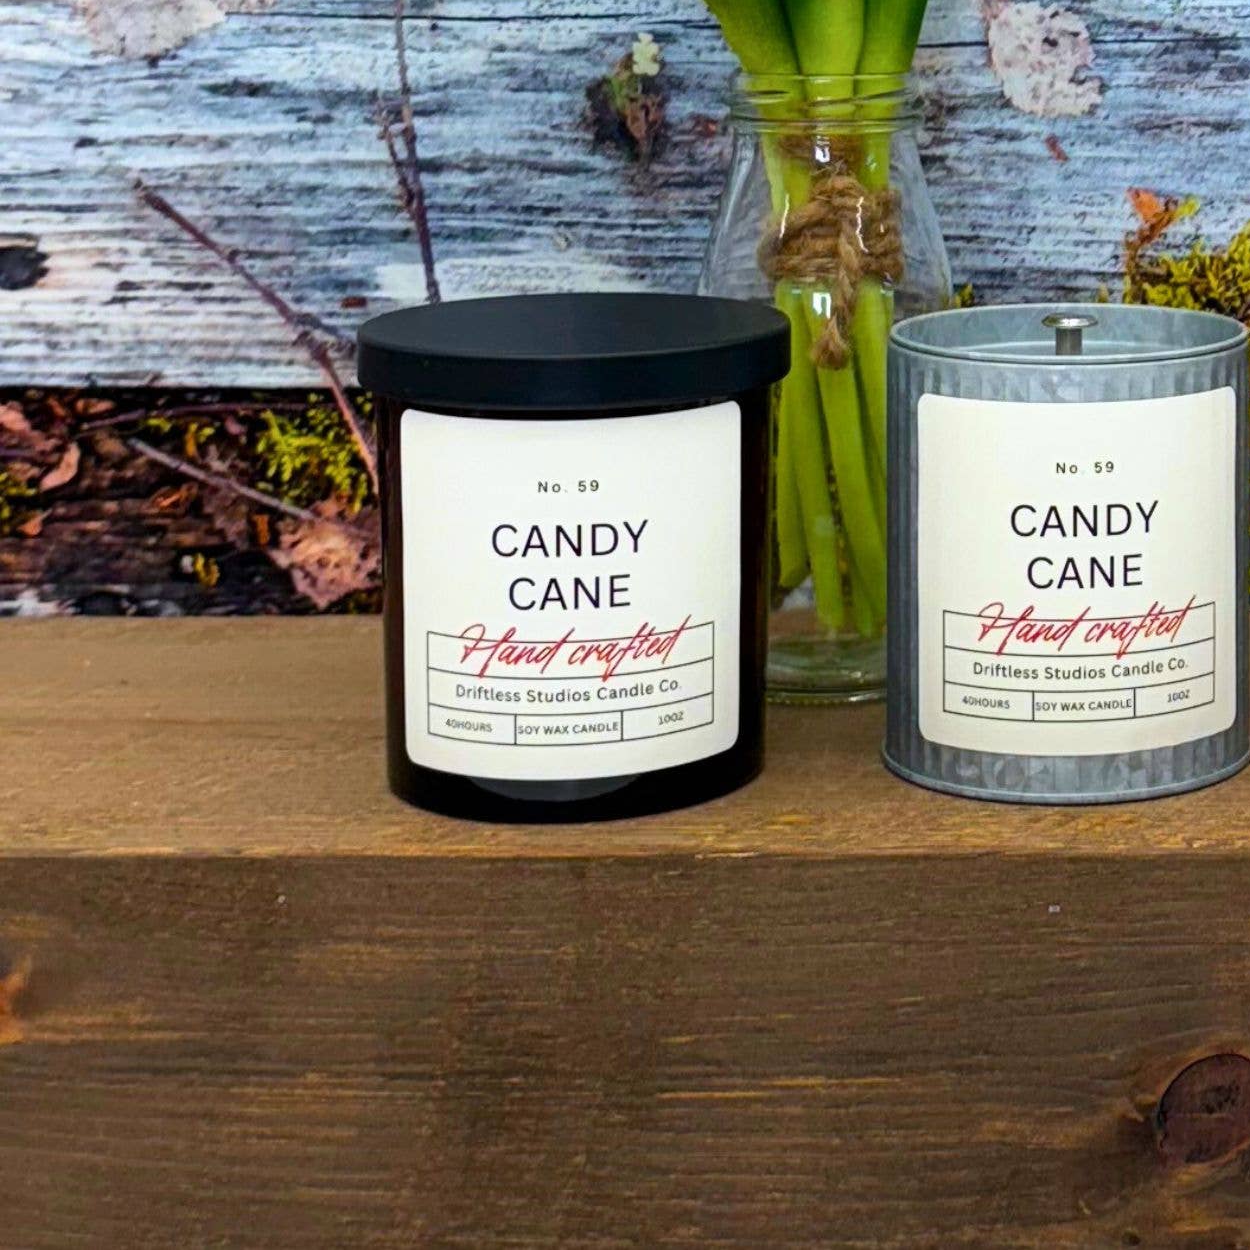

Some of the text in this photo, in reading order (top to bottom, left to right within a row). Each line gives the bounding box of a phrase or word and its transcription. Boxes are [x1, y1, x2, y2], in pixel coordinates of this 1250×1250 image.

[1094, 461, 1115, 473] 59
[578, 480, 600, 493] 59
[1010, 500, 1159, 537] CANDY
[491, 519, 648, 558] CANDY
[1027, 553, 1143, 589] CANE
[509, 574, 631, 611] CANE
[977, 595, 1196, 660] Hand crafted
[458, 614, 692, 682] Hand crafted
[973, 657, 1189, 680] Driftless Studios Candle Co.
[455, 679, 682, 703] Driftless Studios Candle Co.
[962, 694, 1011, 710] 40HOURS
[1035, 698, 1132, 712] SOY WAX CANDLE
[445, 718, 493, 733] 40HOURS
[517, 721, 619, 735] SOY WAX CANDLE
